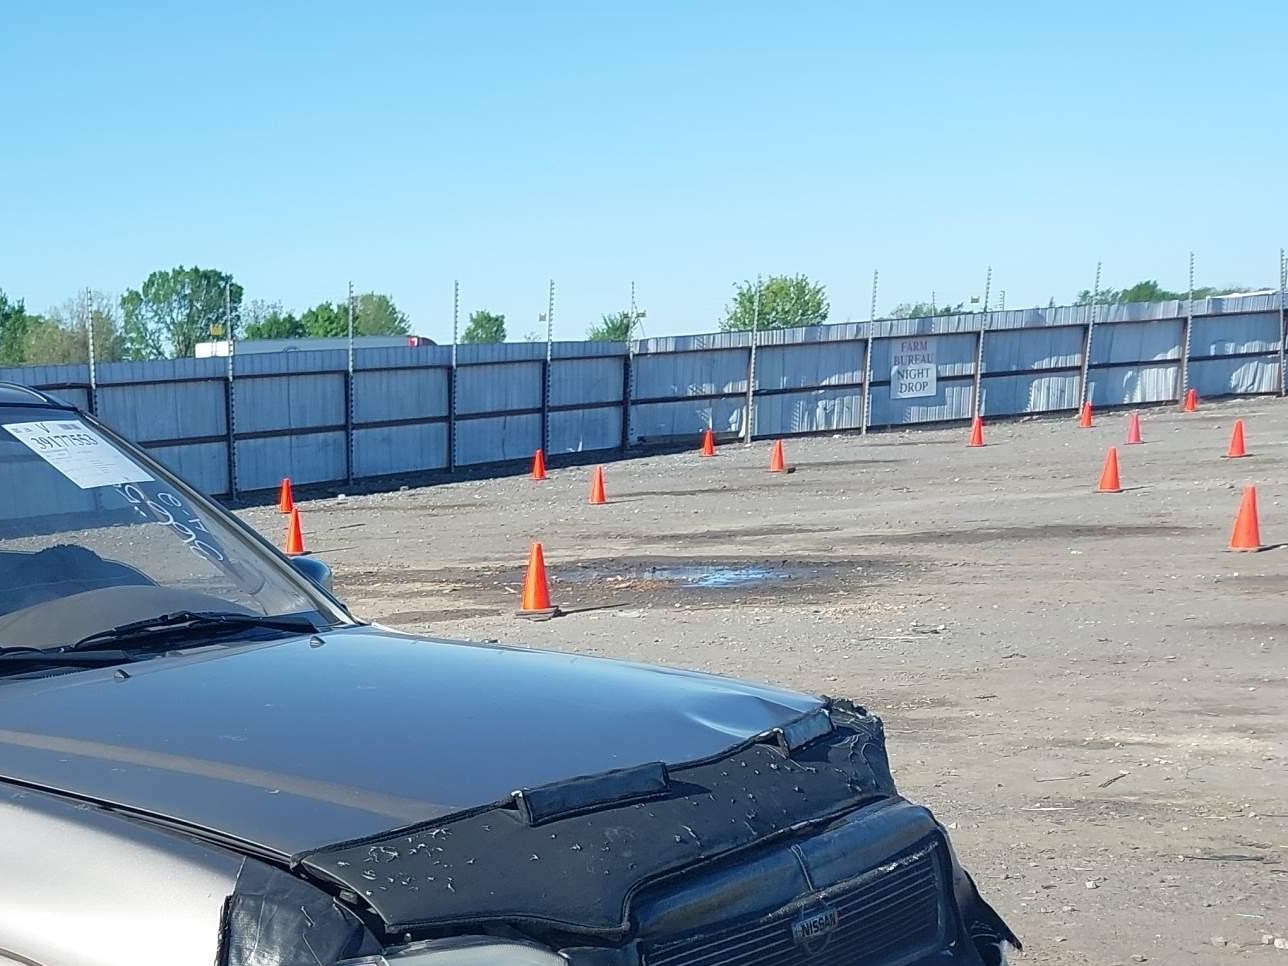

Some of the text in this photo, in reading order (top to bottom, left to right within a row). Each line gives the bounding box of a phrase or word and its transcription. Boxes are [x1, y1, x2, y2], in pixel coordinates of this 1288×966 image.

[901, 340, 928, 352] FARM
[897, 367, 930, 379] NIGHT
[899, 381, 929, 393] DROP
[30, 433, 98, 449] 39177553
[801, 910, 838, 937] NISSAN
